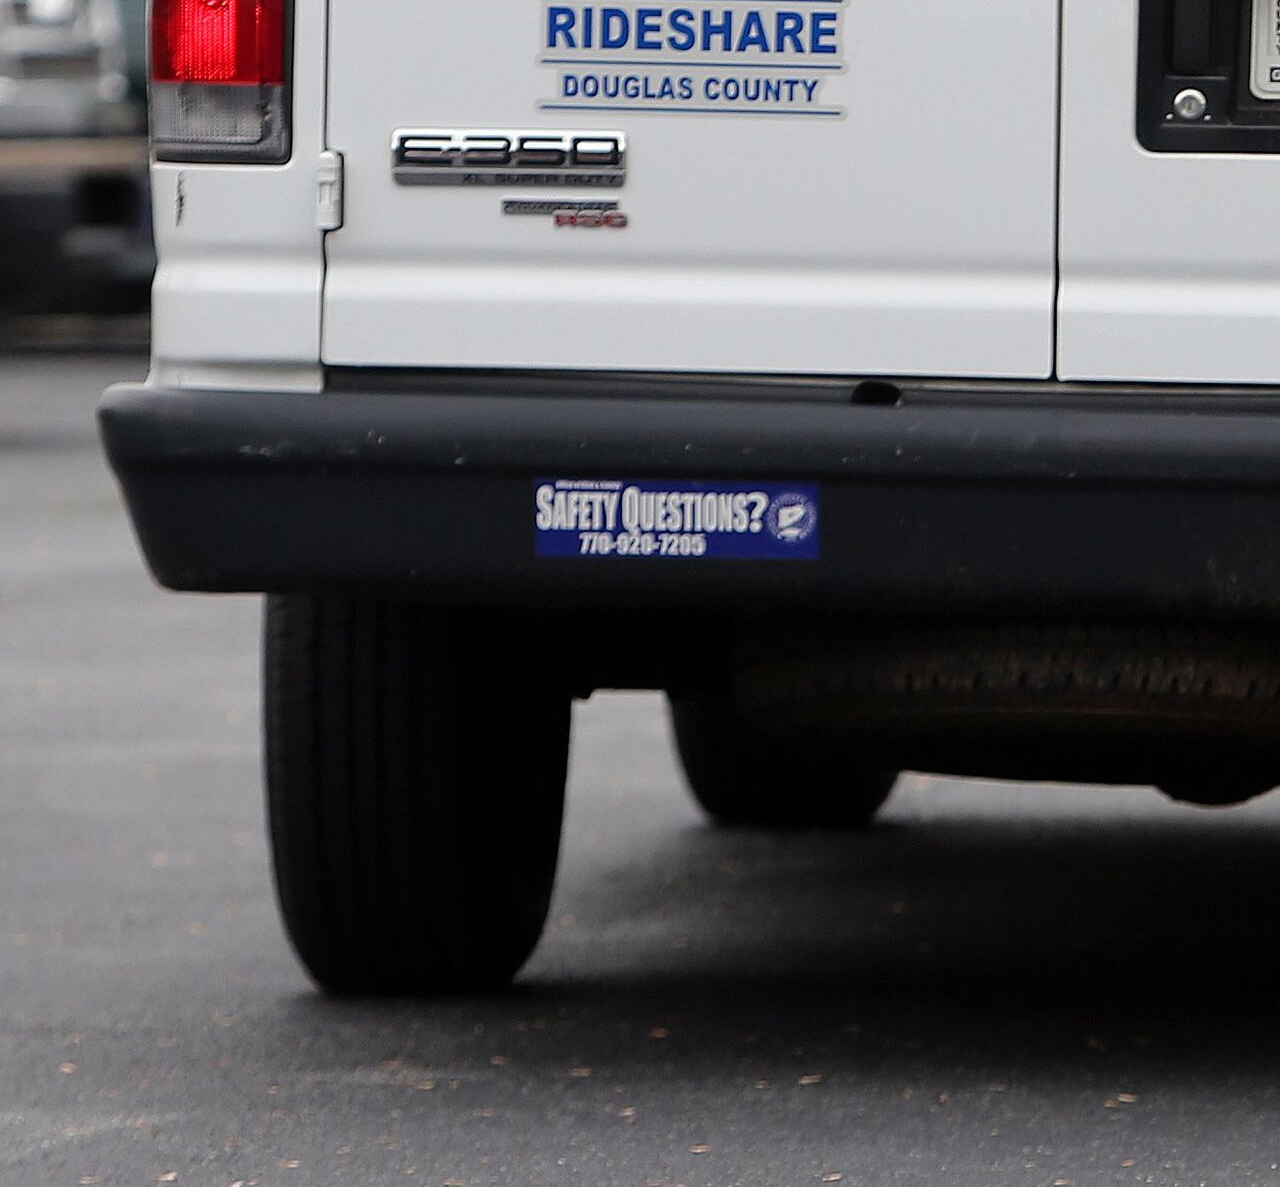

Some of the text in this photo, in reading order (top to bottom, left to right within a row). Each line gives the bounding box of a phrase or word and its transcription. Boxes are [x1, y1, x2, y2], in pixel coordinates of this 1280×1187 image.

[547, 6, 837, 54] RIDESHARE
[562, 74, 819, 103] DOUGLAS COUNTY
[536, 485, 620, 531] SAFETY
[622, 486, 768, 534] QUESTIONS?
